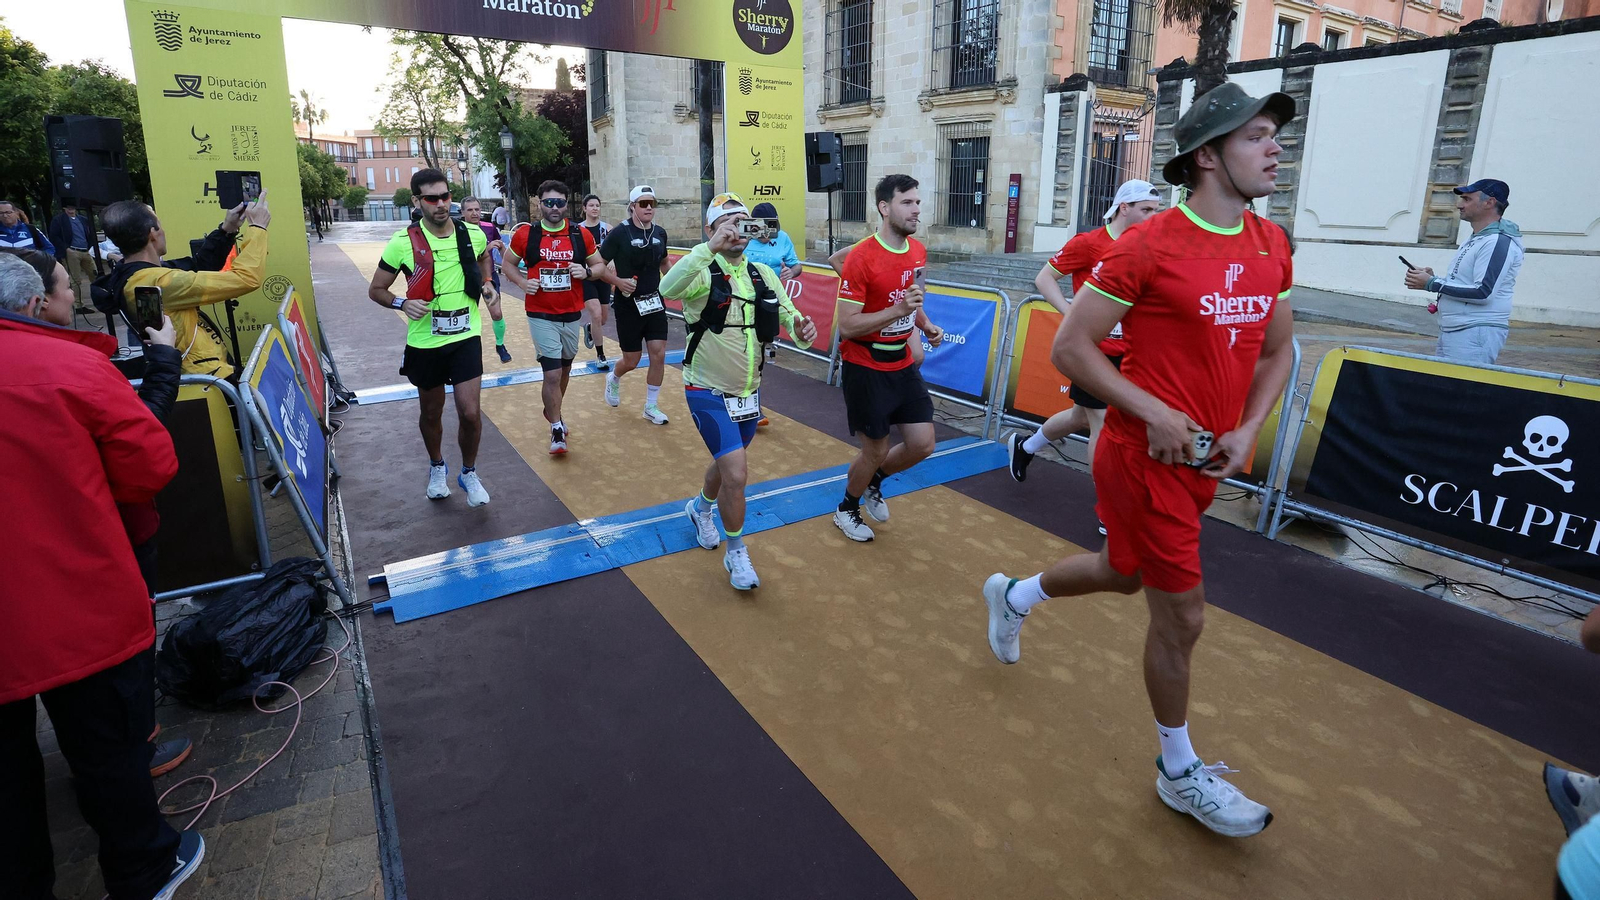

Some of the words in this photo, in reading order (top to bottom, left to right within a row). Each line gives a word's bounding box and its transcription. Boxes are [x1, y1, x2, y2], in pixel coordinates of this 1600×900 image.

[738, 8, 789, 33] Sherry
[188, 25, 261, 40] Ayuntamiento
[747, 23, 782, 35] Maratón
[189, 35, 202, 43] de
[205, 36, 231, 46] Jerez
[207, 75, 267, 89] Diputación
[755, 77, 793, 86] Ayuntamiento
[209, 91, 224, 101] de
[228, 91, 258, 102] Cádiz
[761, 111, 793, 121] Diputación
[762, 121, 770, 129] de
[771, 121, 787, 130] Cádiz
[753, 185, 781, 195] HSN
[539, 248, 574, 260] Sherry
[264, 276, 291, 292] VALDESPIN
[548, 275, 563, 284] 136
[888, 288, 907, 303] She
[1199, 292, 1273, 319] Sherry
[447, 317, 459, 327] 19
[1213, 312, 1261, 326] Maratón
